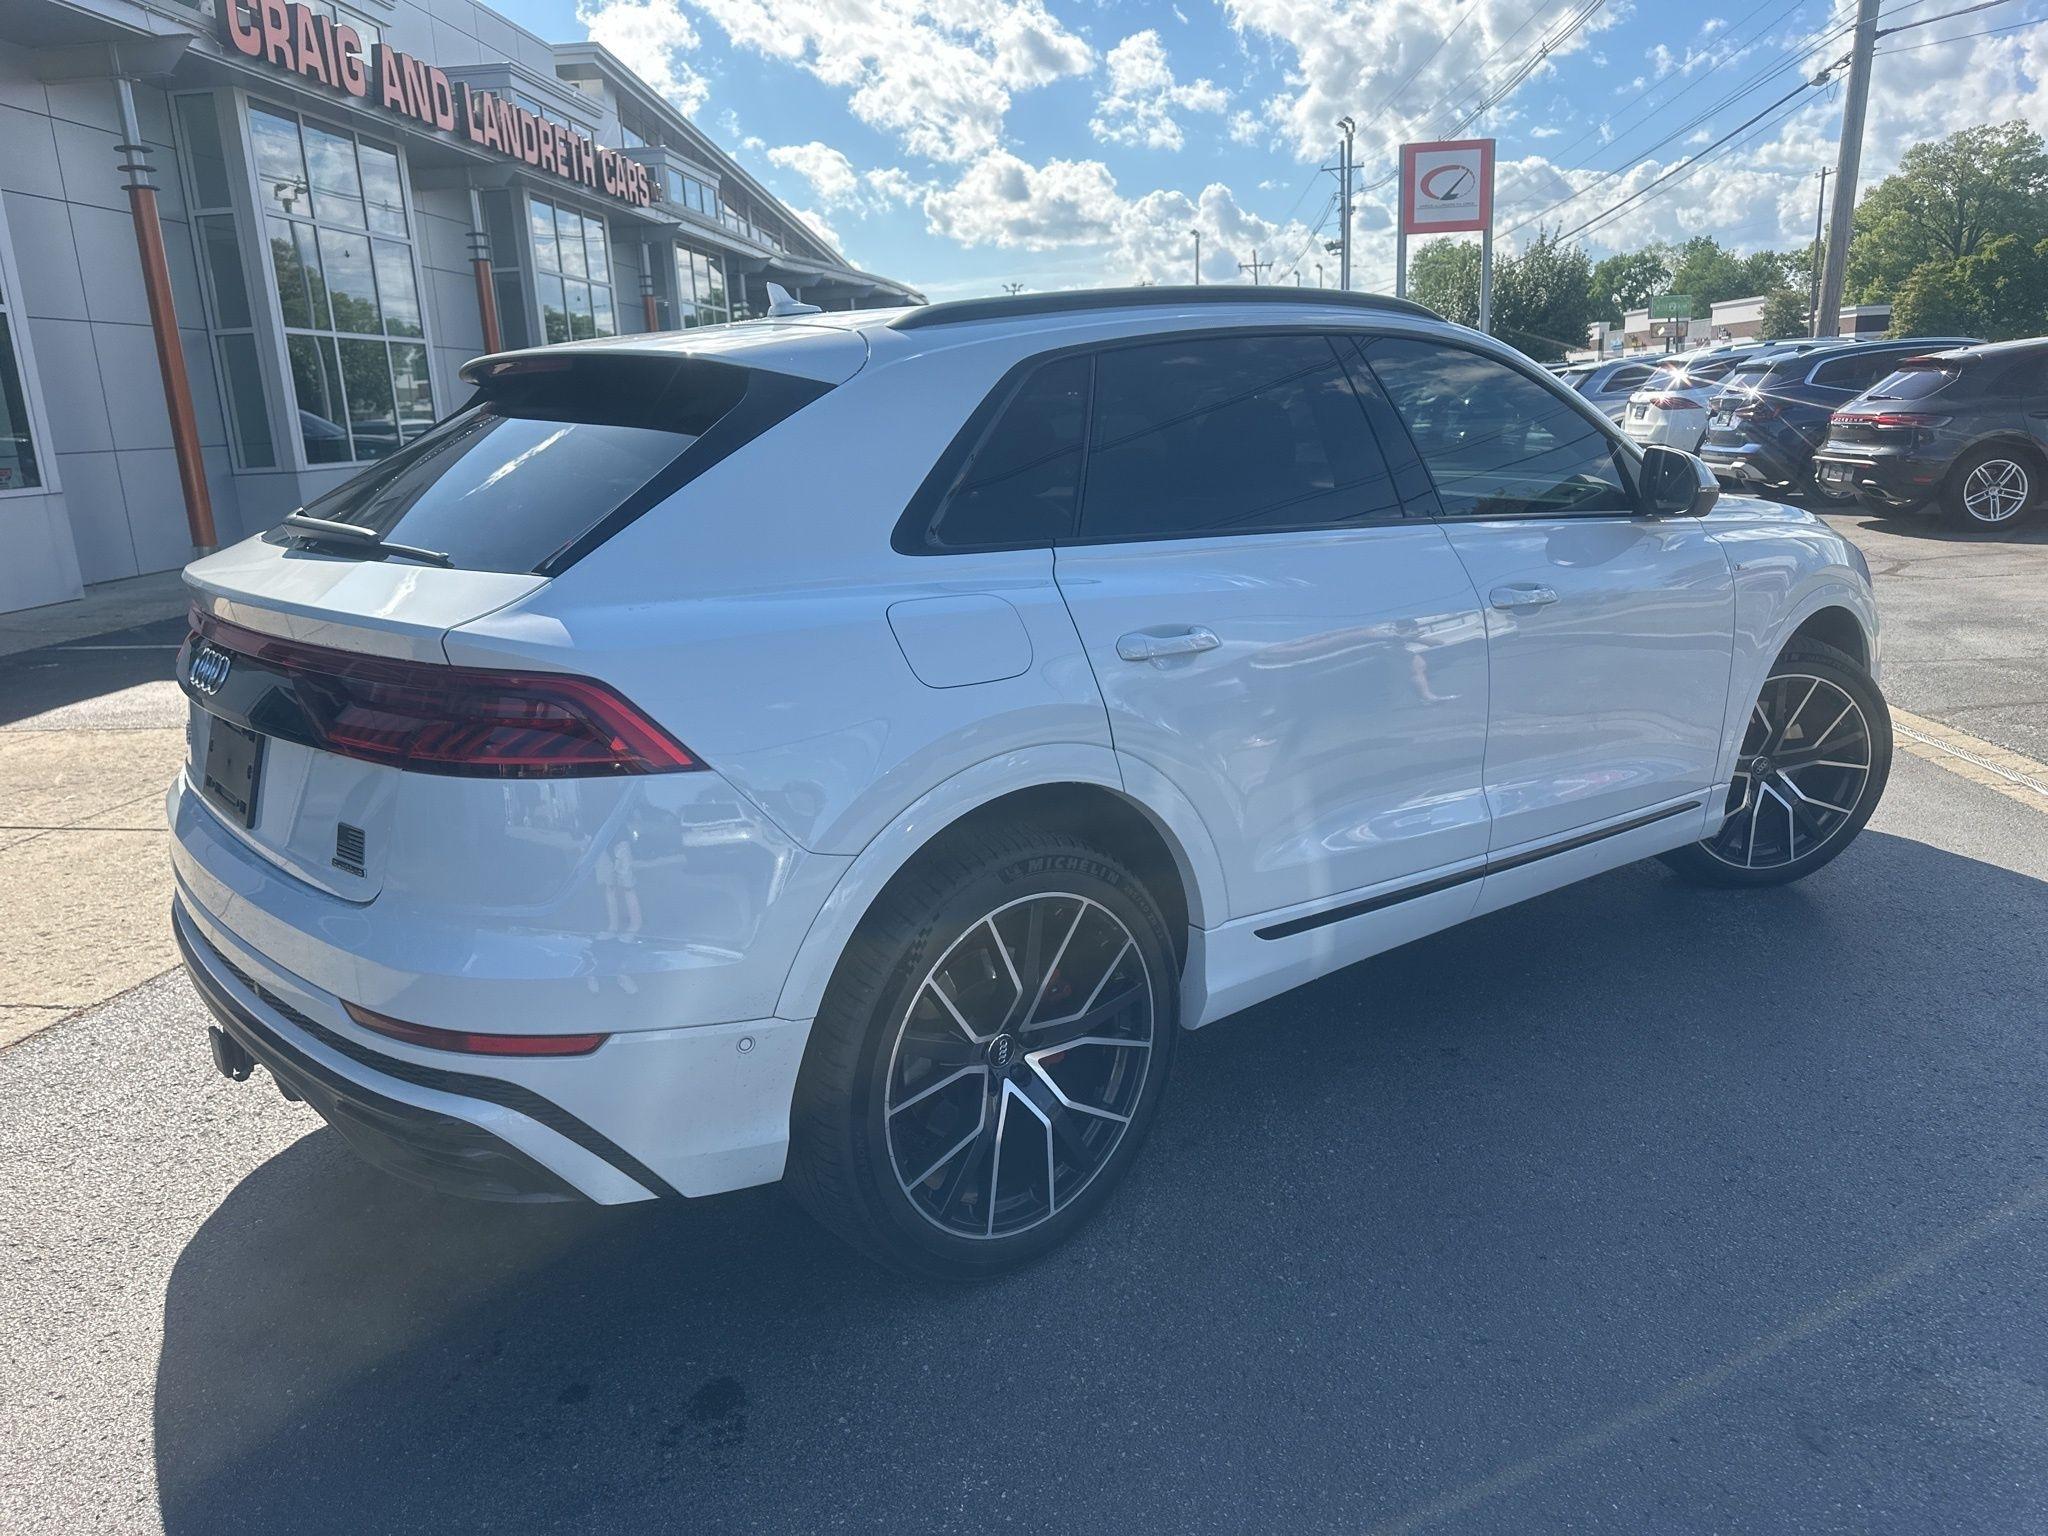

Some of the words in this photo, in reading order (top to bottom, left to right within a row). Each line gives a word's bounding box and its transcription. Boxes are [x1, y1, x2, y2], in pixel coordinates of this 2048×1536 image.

[225, 0, 367, 97] CRAIG
[380, 43, 455, 132] AND
[463, 81, 598, 188] LANDRETH
[601, 149, 651, 208] CARS
[1028, 857, 1120, 886] MICHELIN
